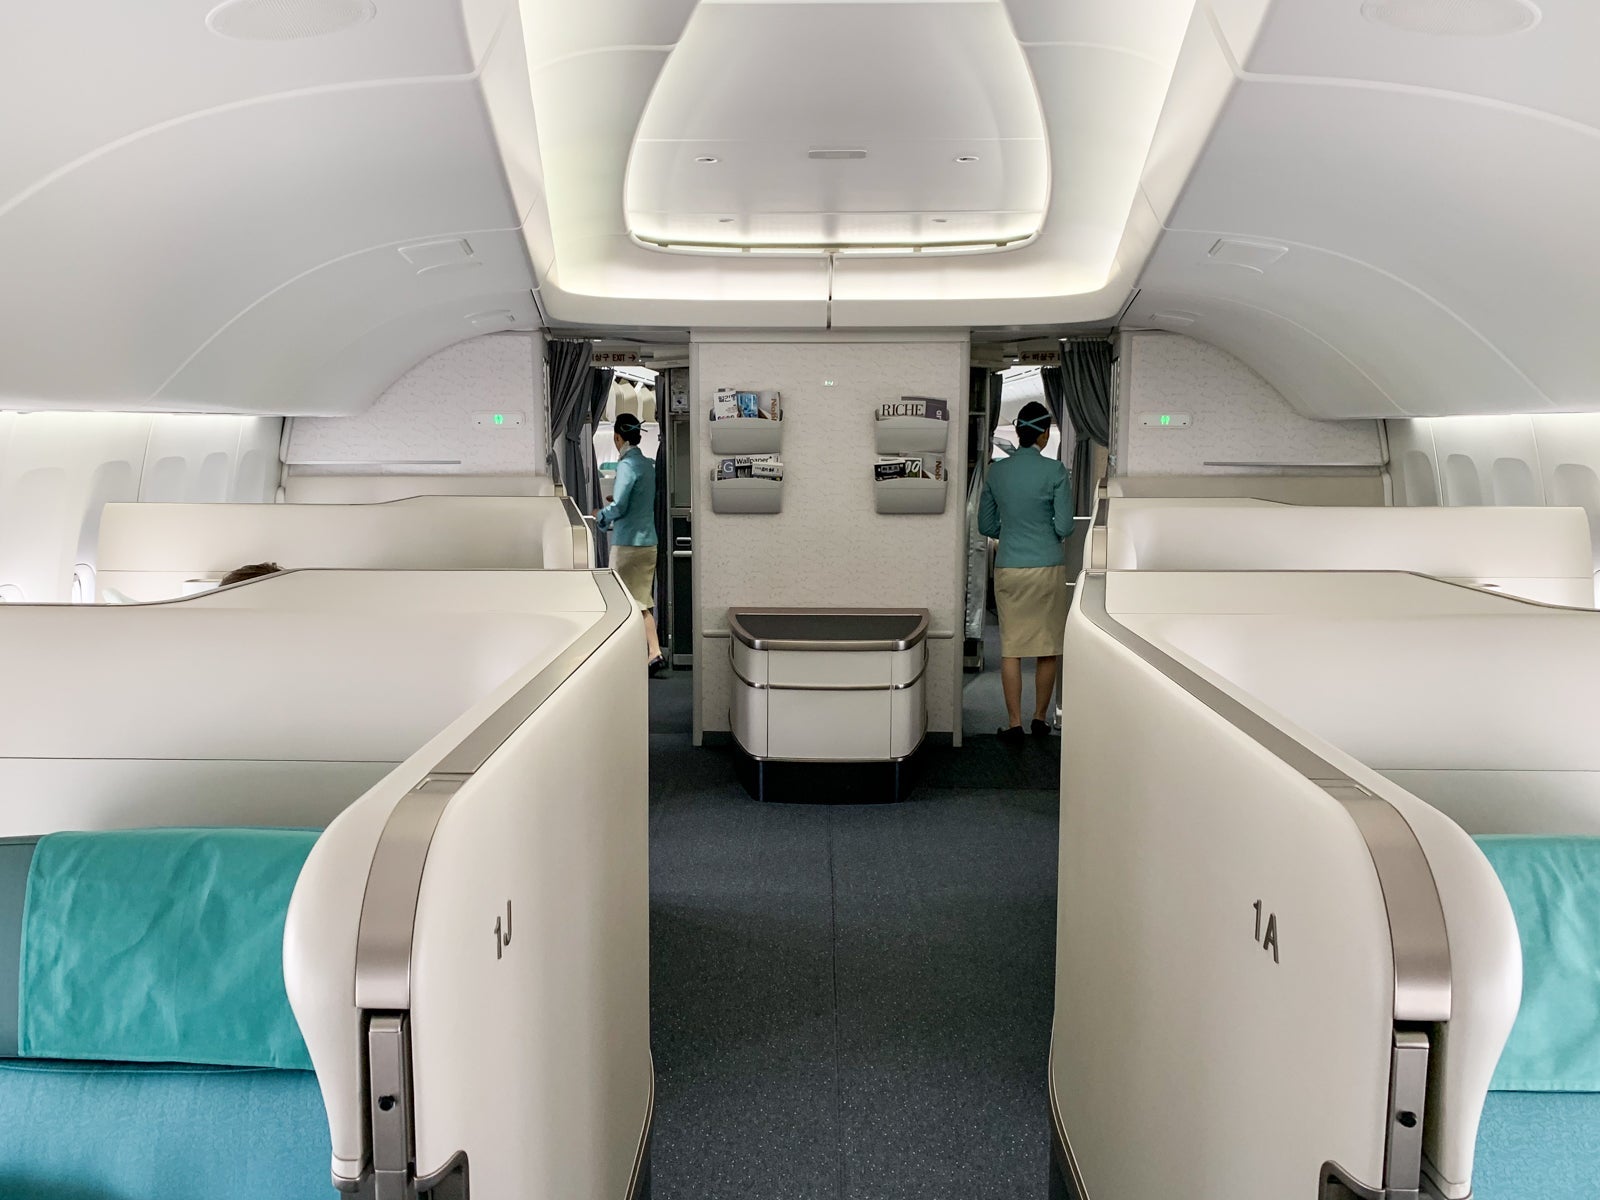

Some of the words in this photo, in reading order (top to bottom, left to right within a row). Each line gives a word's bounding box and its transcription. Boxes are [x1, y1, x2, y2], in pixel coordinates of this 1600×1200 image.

[612, 353, 625, 361] EXIT
[882, 403, 924, 417] RICHE
[493, 899, 512, 960] 1J
[1252, 899, 1280, 965] 1A
